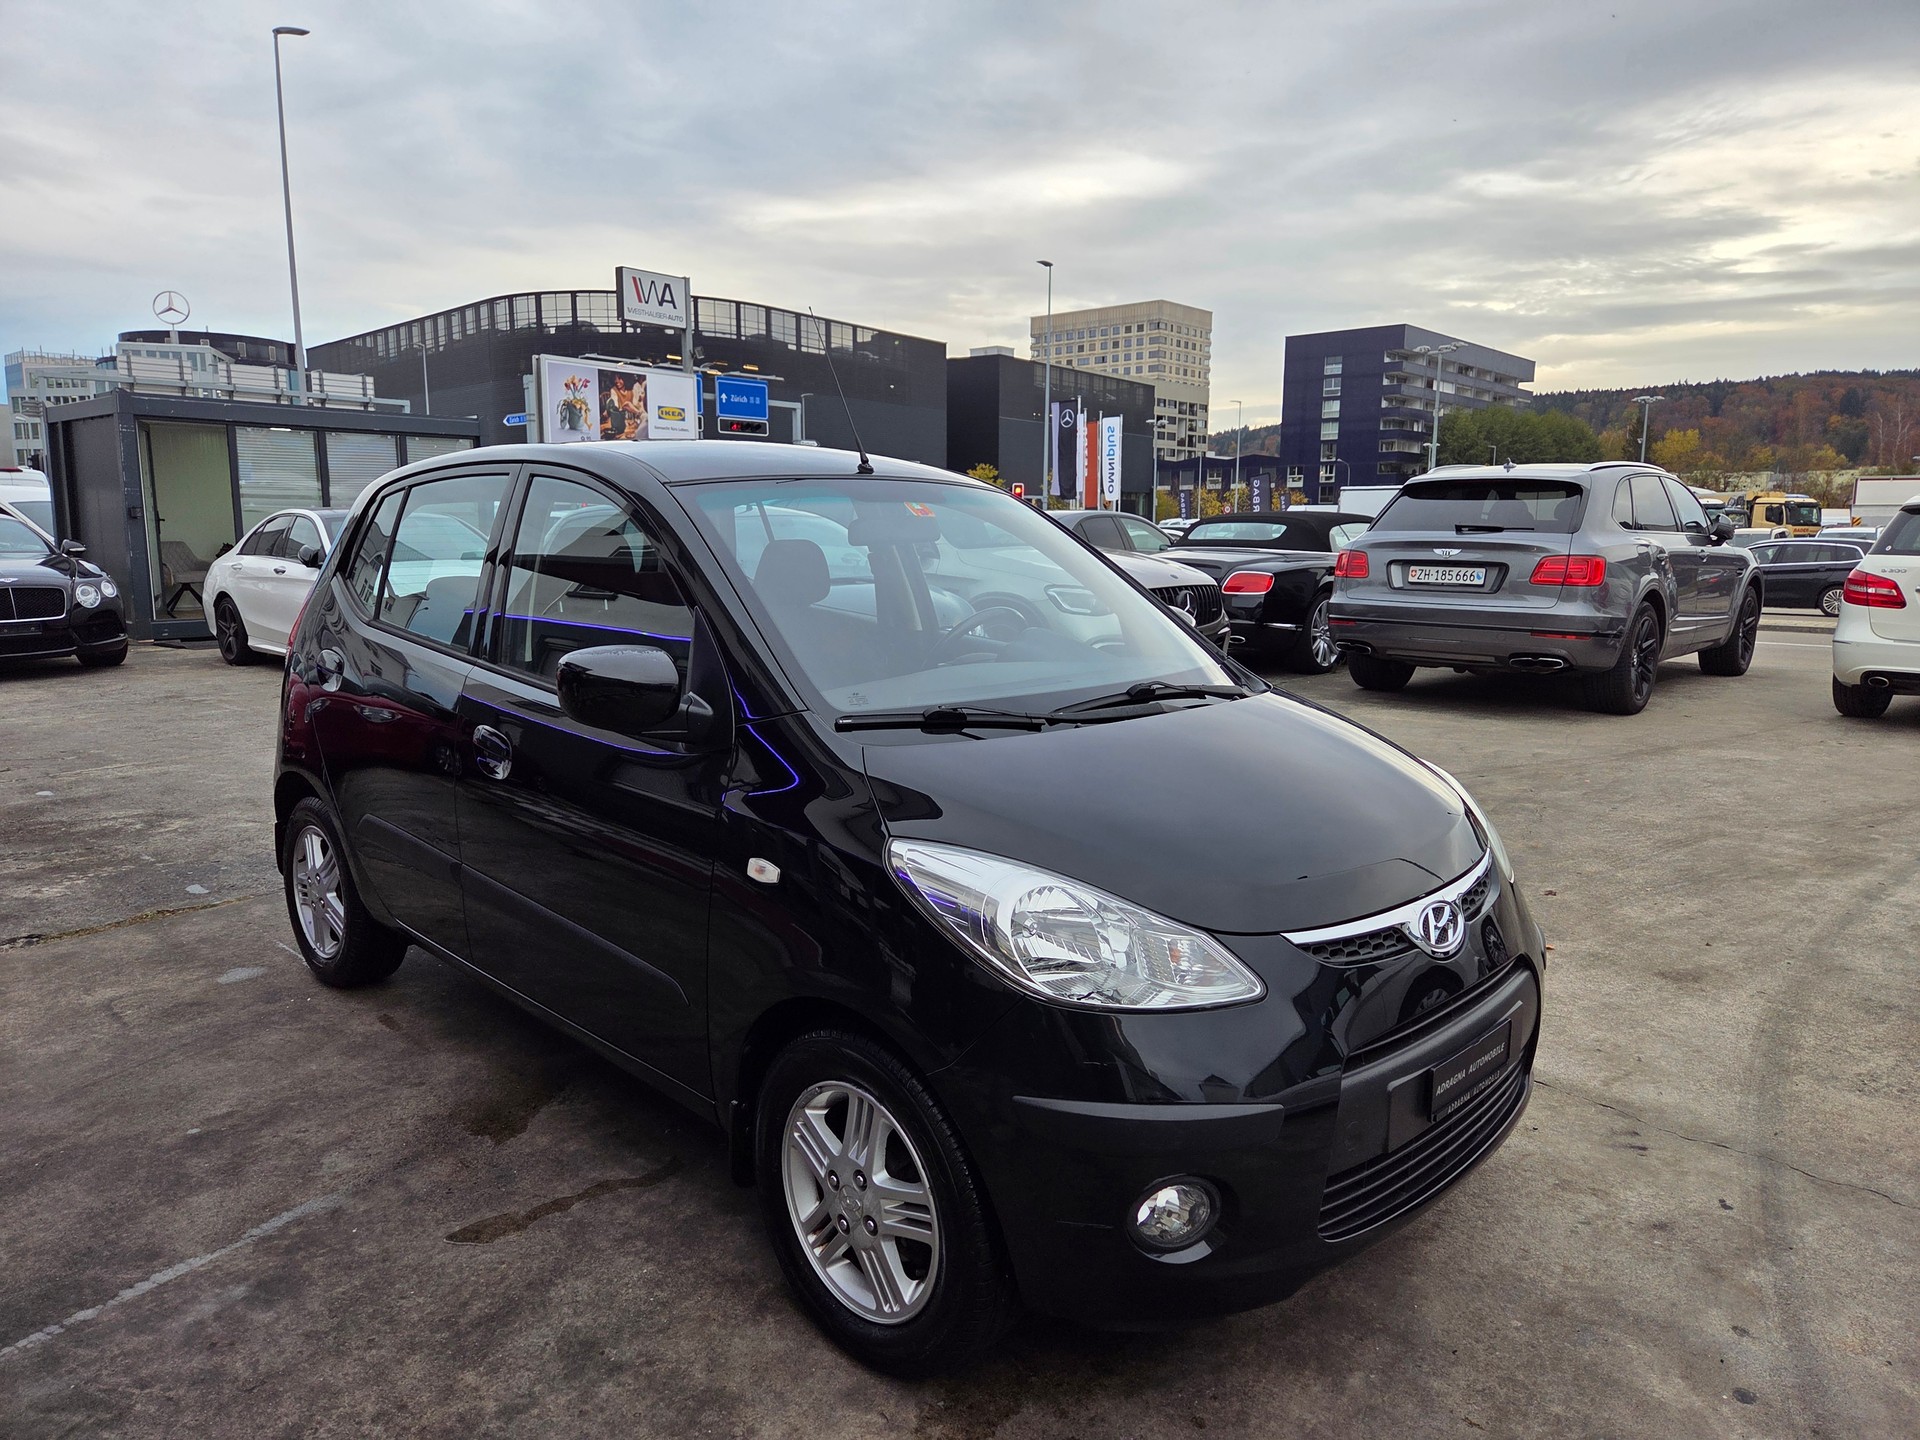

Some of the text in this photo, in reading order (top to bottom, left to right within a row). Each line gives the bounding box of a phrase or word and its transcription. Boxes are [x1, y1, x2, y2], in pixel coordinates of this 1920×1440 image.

[730, 394, 748, 403] Zürich
[660, 409, 684, 418] IKEA
[1436, 1042, 1506, 1096] ADRAGNA AUTOMOBILE
